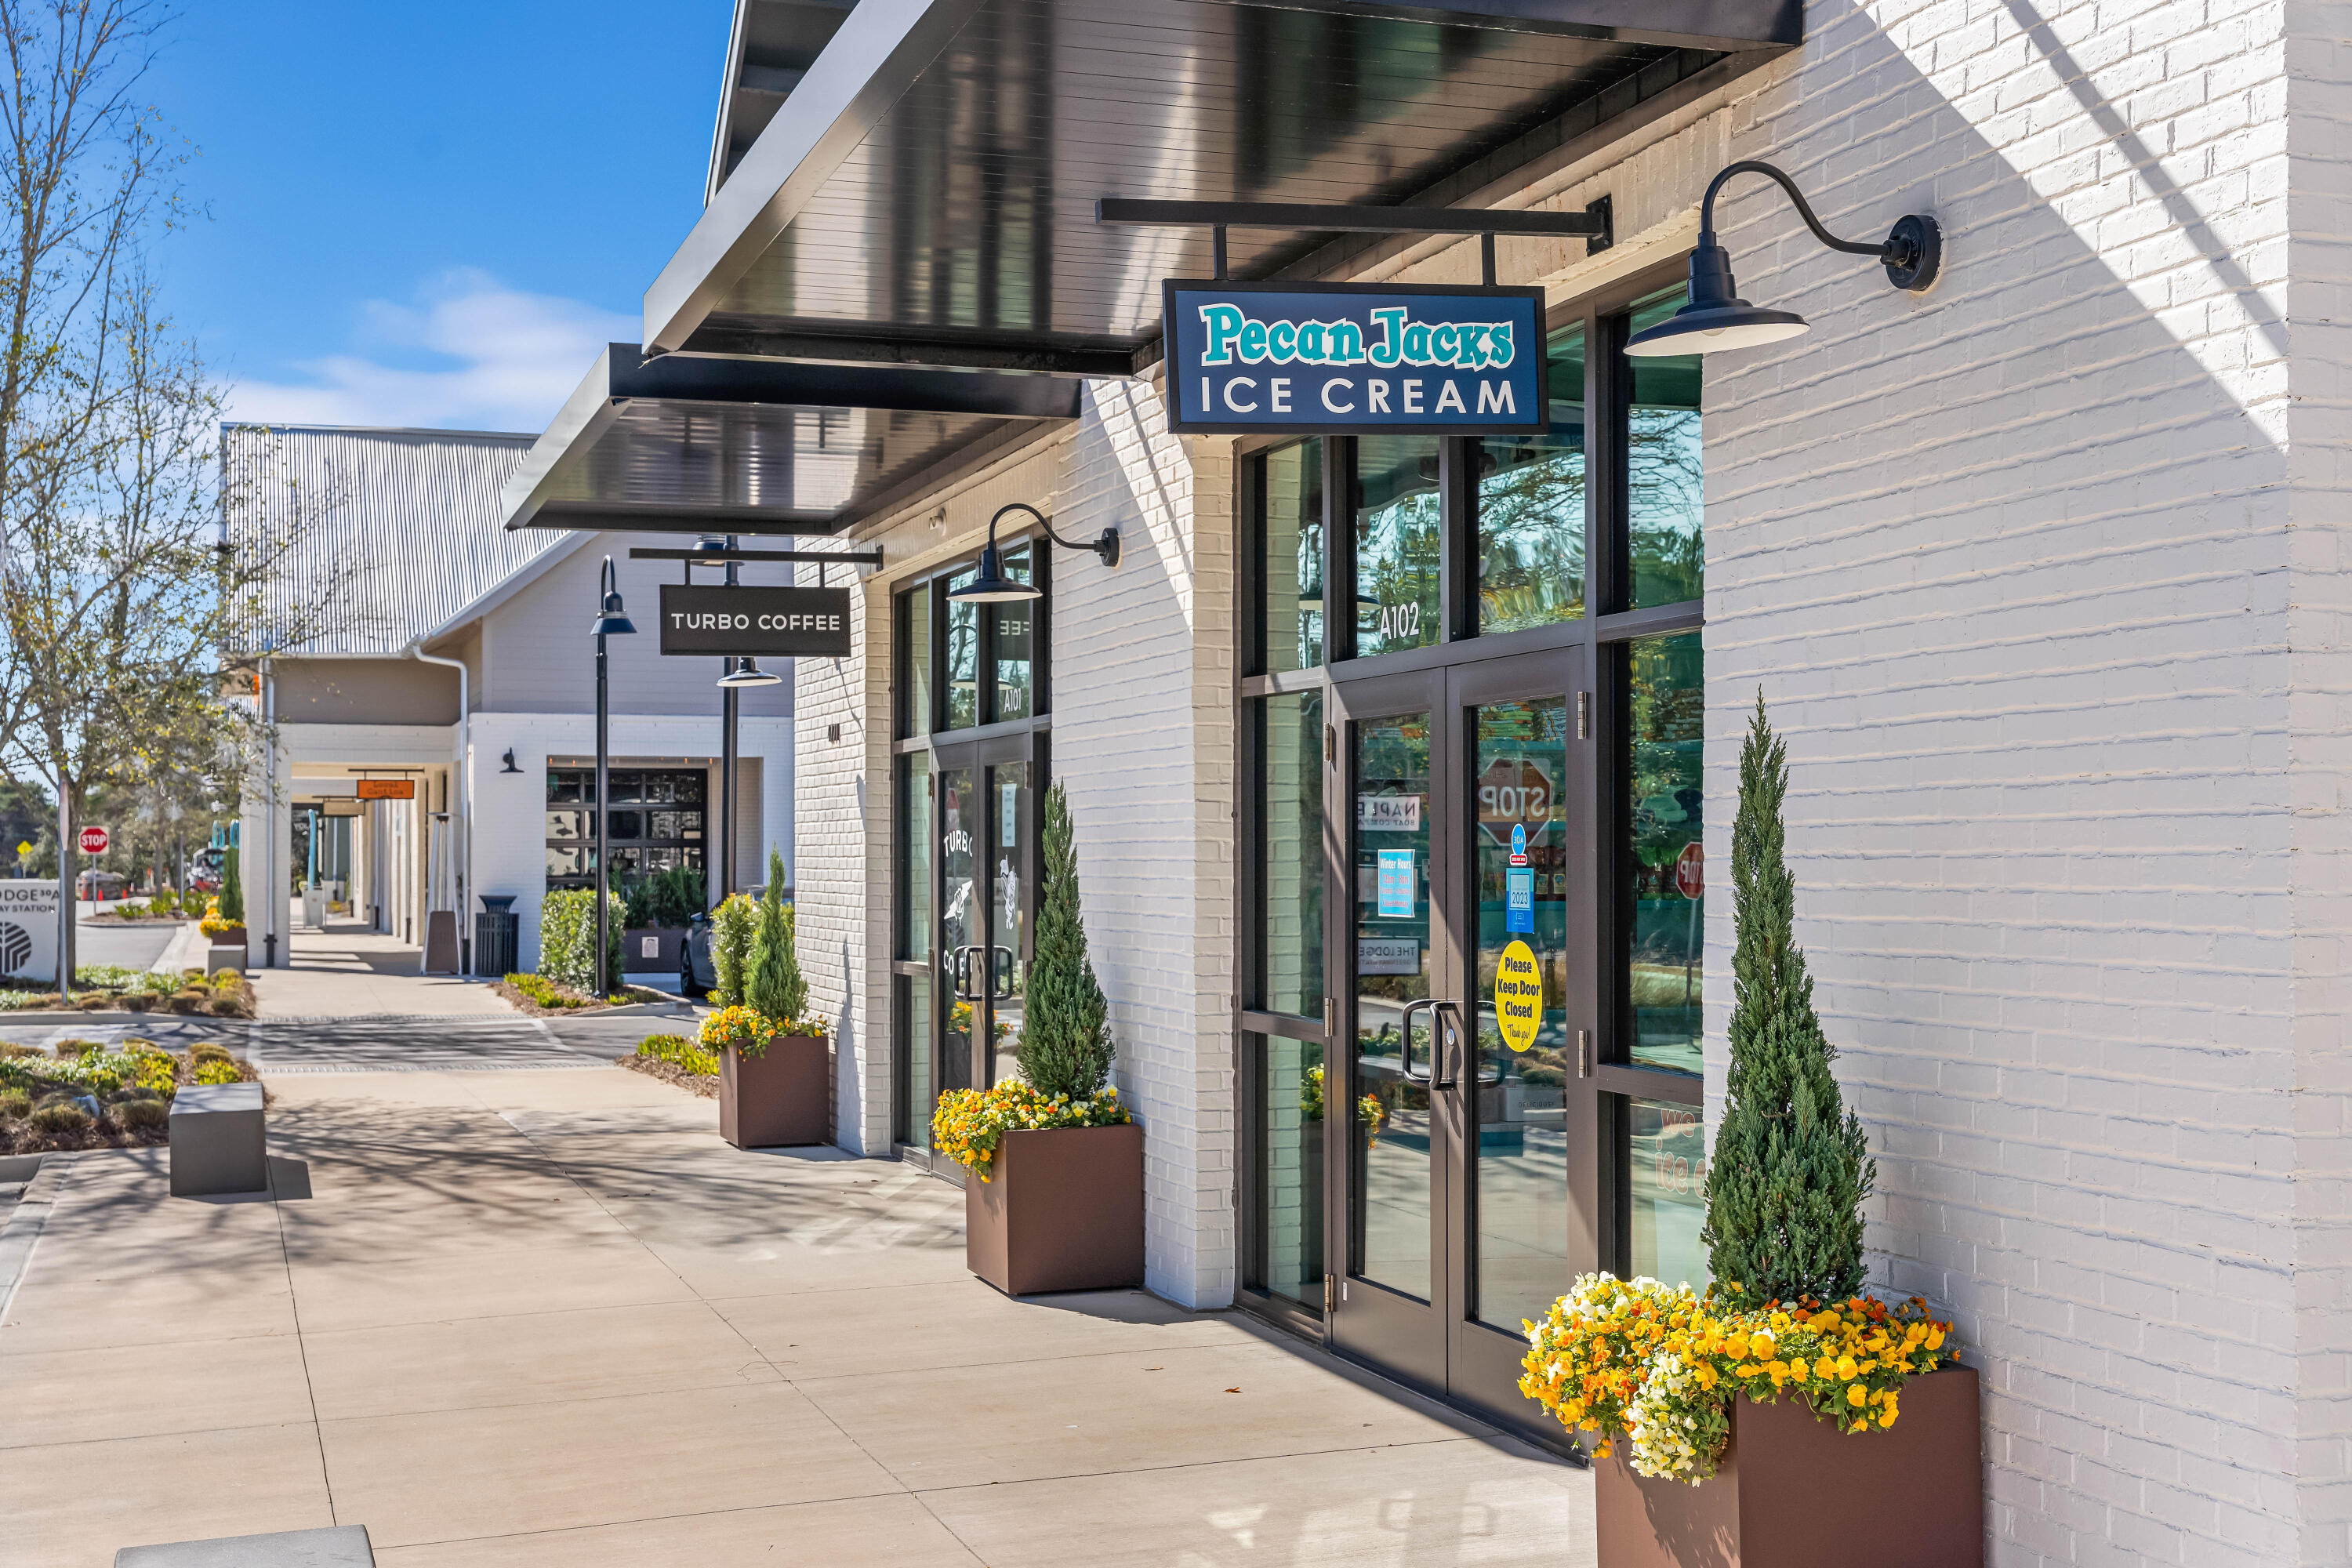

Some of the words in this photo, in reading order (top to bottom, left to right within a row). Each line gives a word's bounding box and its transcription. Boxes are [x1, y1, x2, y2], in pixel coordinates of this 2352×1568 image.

[1198, 303, 1367, 367] Pecan
[1367, 306, 1515, 372] Jacks
[1201, 376, 1292, 413] ICE
[1321, 377, 1517, 415] CREAM
[671, 613, 750, 630] TURBO
[758, 614, 840, 630] COFFEE
[1380, 601, 1419, 641] A102
[1004, 688, 1021, 713] A101
[81, 834, 107, 847] STOP
[1513, 836, 1524, 844] 30A
[1380, 858, 1396, 869] Winter
[1397, 858, 1411, 869] Hours
[1512, 891, 1528, 905] 2023
[1504, 957, 1532, 973] Please
[1497, 978, 1518, 996] Keep
[1519, 980, 1540, 996] Door
[1504, 1001, 1532, 1018] Closed
[1507, 1024, 1521, 1038] Thank
[1661, 1109, 1695, 1138] we
[1655, 1135, 1689, 1196] ice
